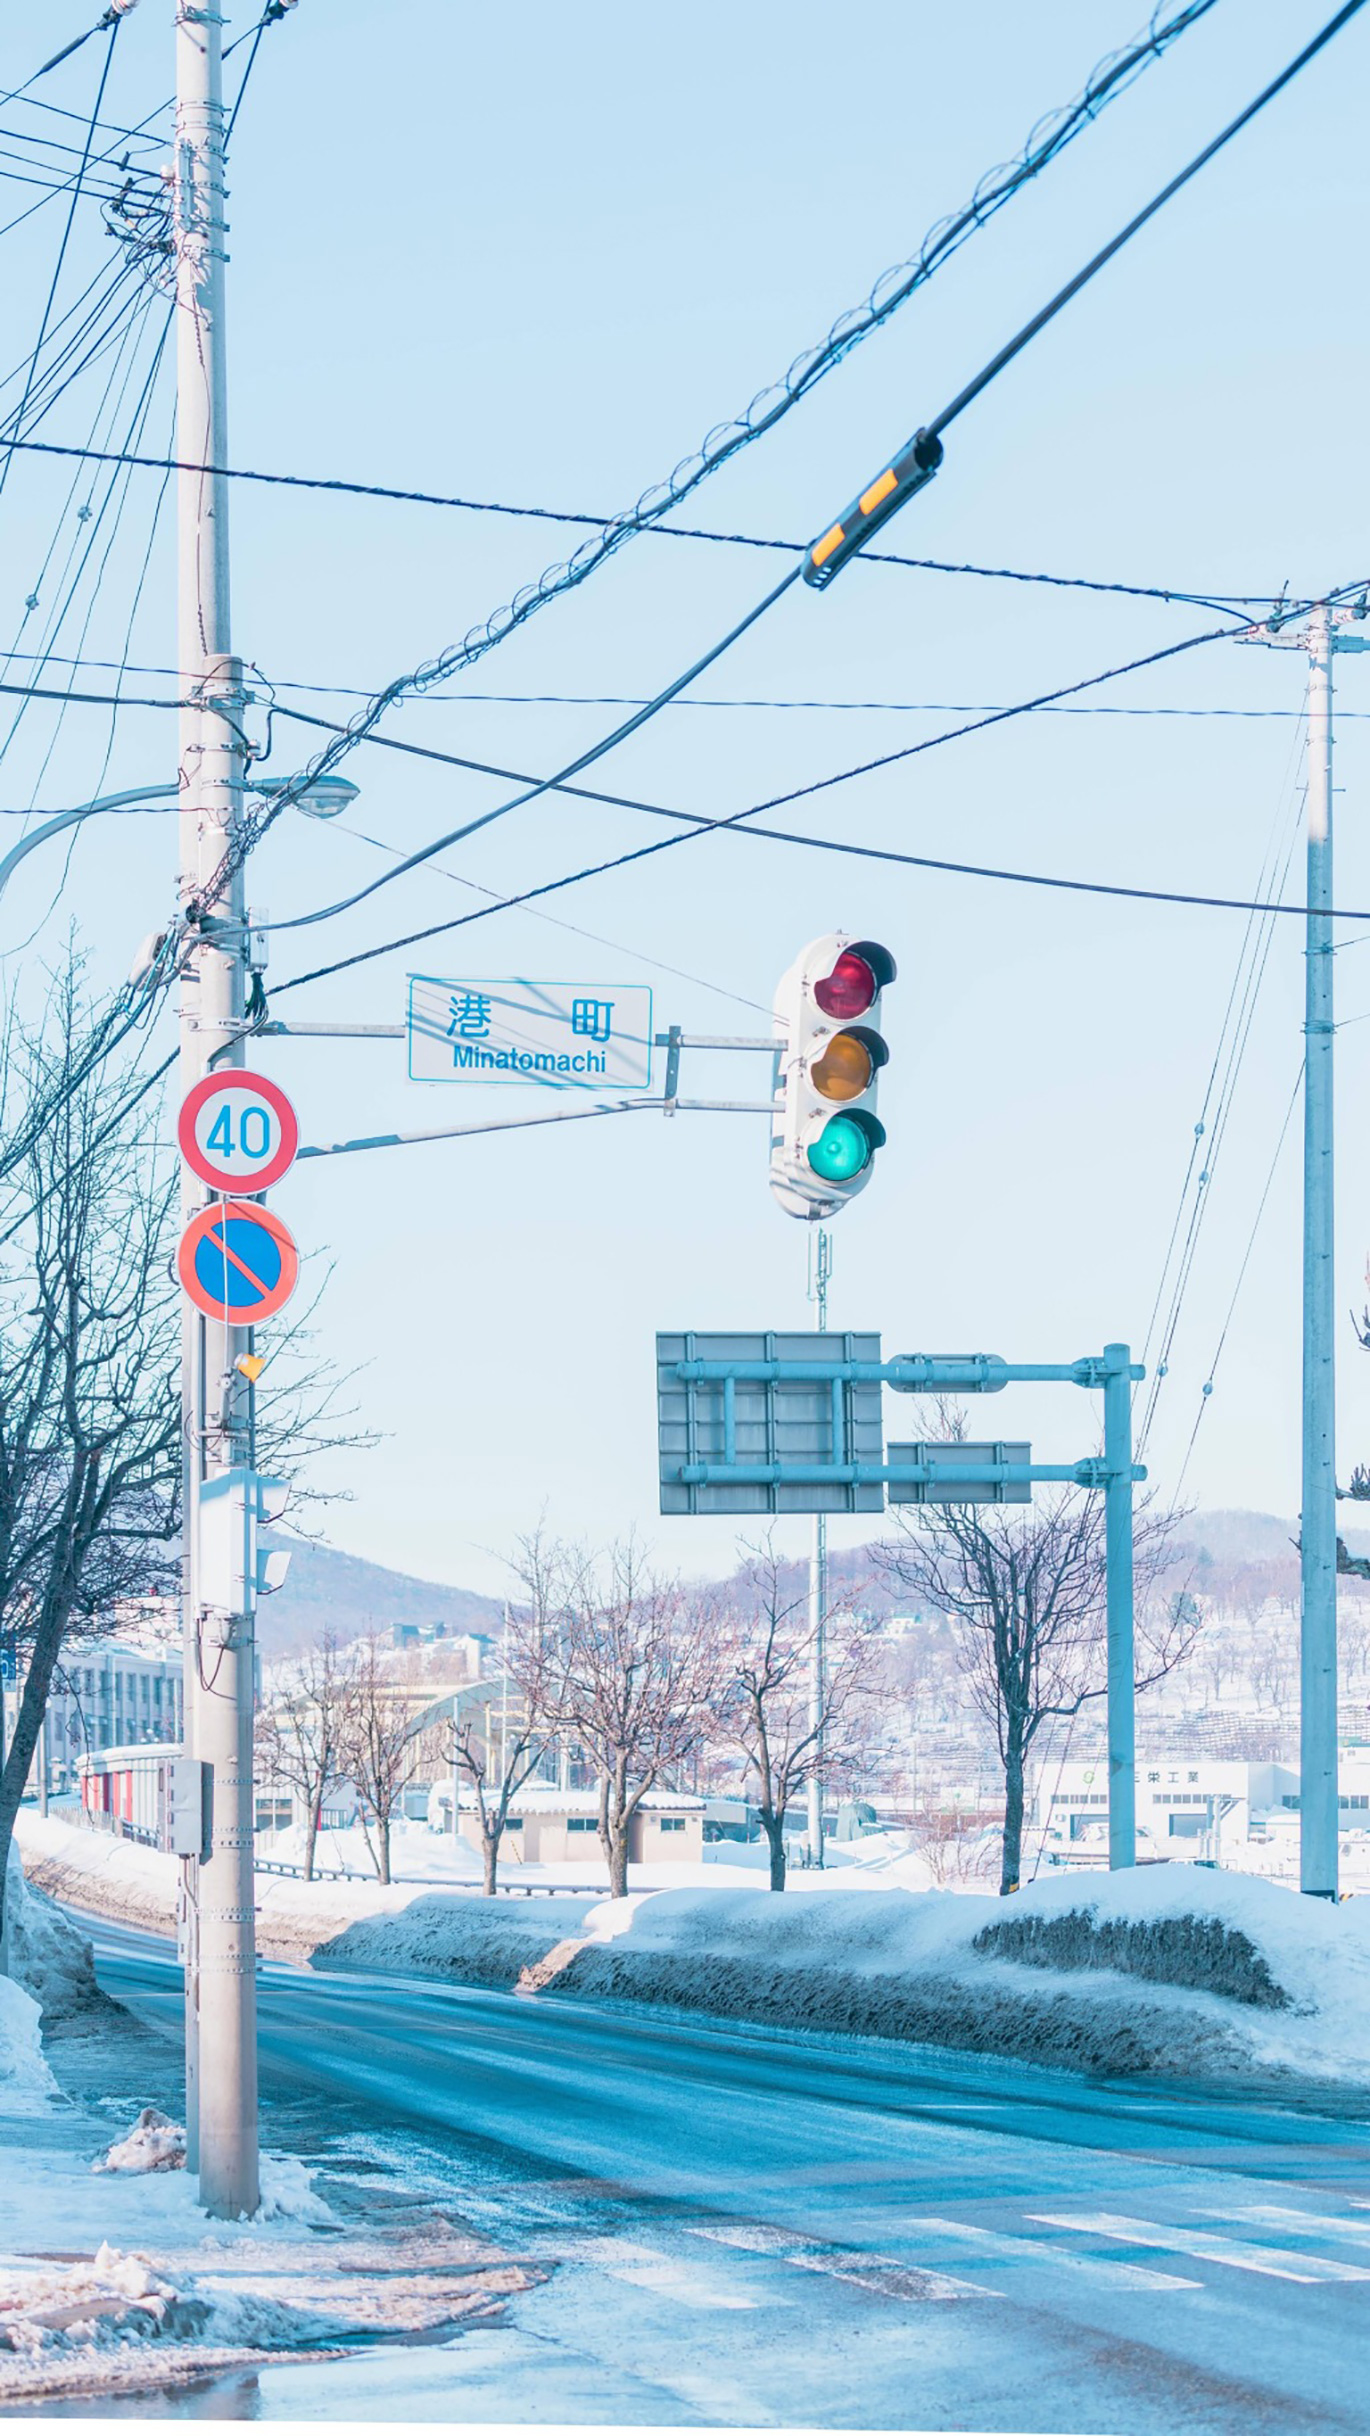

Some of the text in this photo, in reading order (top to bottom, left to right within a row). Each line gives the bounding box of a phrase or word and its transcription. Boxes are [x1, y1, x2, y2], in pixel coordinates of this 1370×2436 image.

[446, 995, 615, 1043] 港町
[453, 1045, 606, 1073] Minatomachi
[206, 1104, 270, 1159] 40
